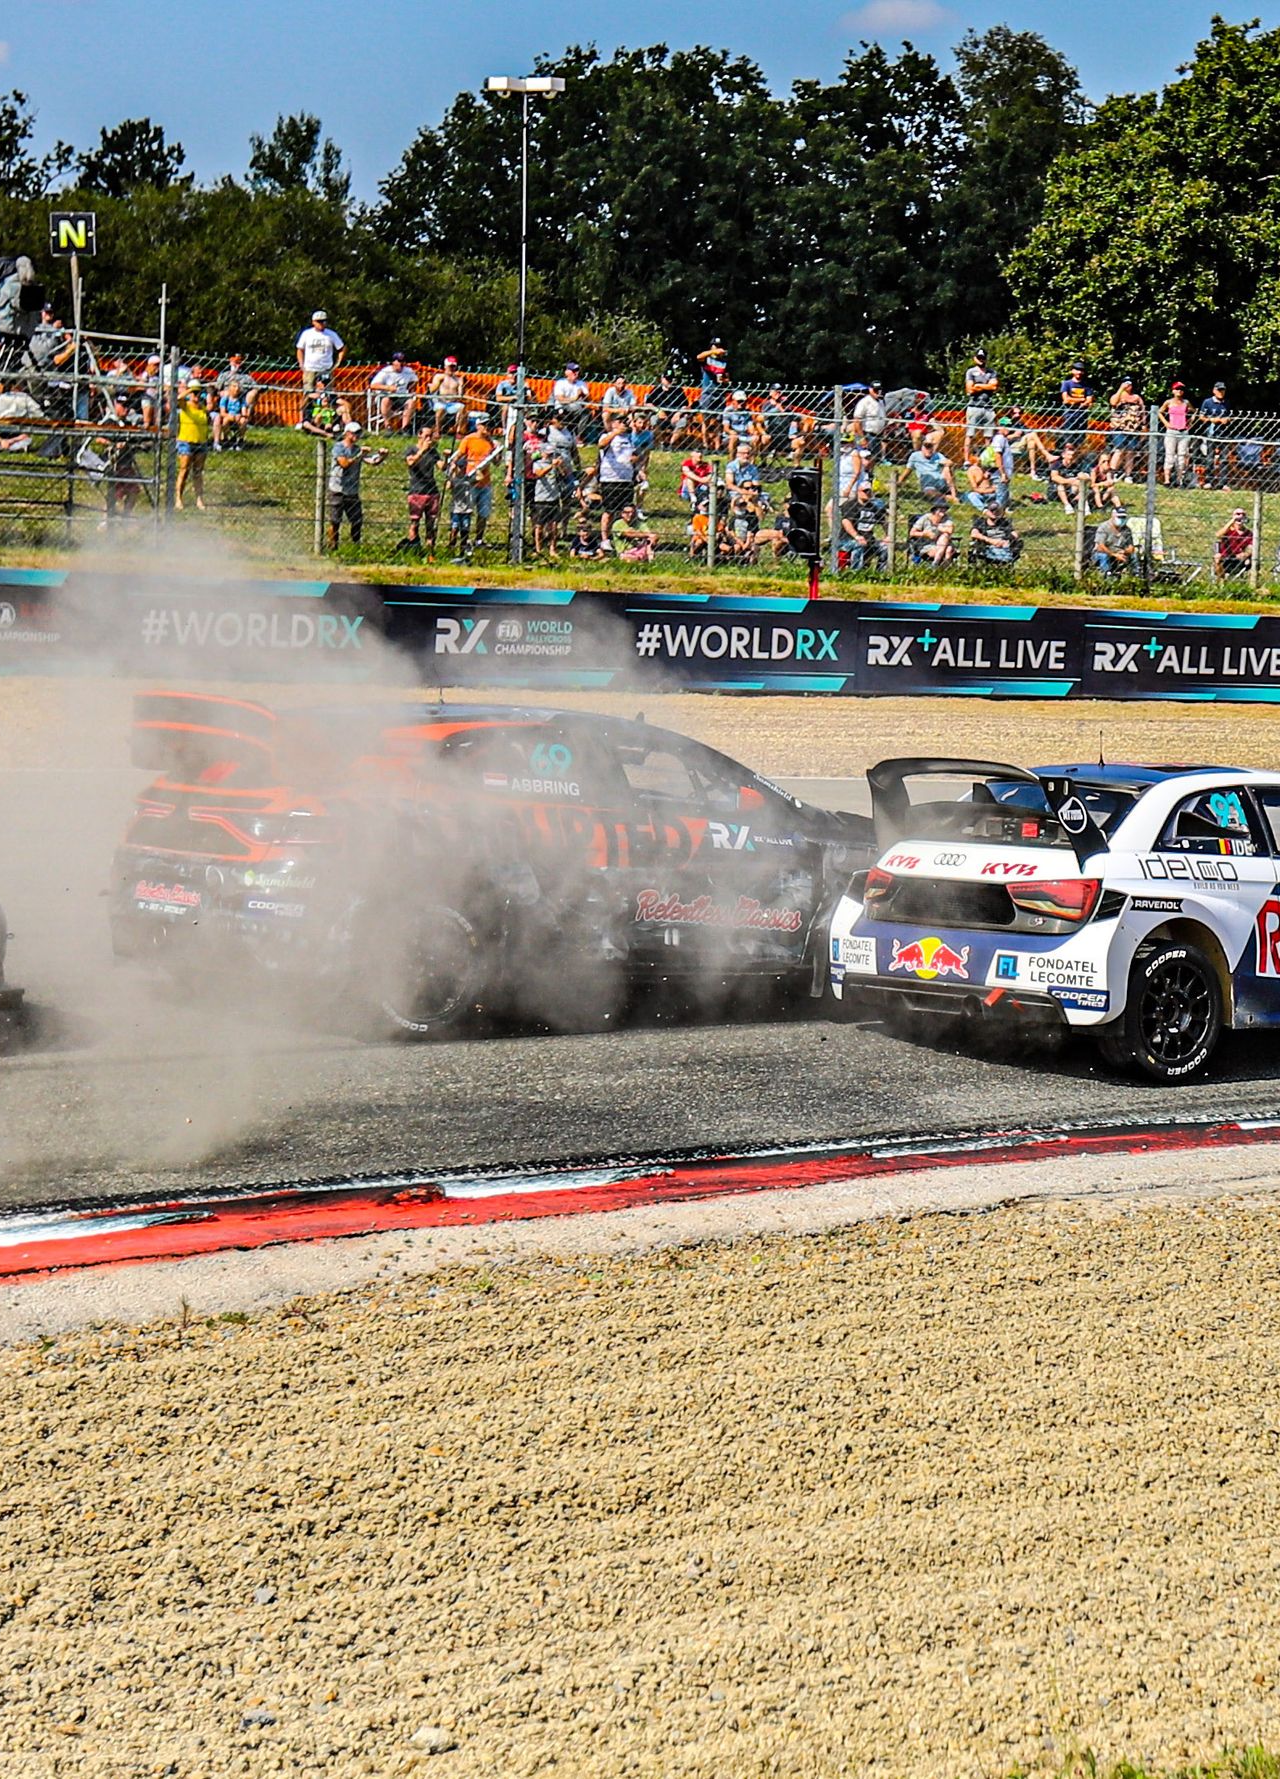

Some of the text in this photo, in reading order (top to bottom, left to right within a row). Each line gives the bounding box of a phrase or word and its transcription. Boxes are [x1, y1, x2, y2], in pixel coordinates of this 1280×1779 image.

[59, 220, 86, 248] N
[141, 609, 364, 650] #WORLDRX
[435, 618, 490, 654] RX
[497, 622, 521, 640] FIA
[526, 620, 572, 634] WORLD
[495, 643, 571, 656] CHAMPIONSHIP
[636, 623, 840, 661] #WORLDRX
[999, 639, 1066, 670] LIVE
[529, 743, 572, 775] 69
[511, 778, 580, 796] ABBRING
[1210, 792, 1248, 828] 91
[709, 822, 756, 852] RX
[885, 854, 921, 869] KYB
[980, 862, 1039, 876] KYB
[1028, 956, 1098, 974] FONDATEL
[1145, 950, 1187, 978] COOPER
[1030, 971, 1094, 987] LECOMTE
[1051, 990, 1107, 1002] COOPER
[1167, 1048, 1208, 1076] COOPER
